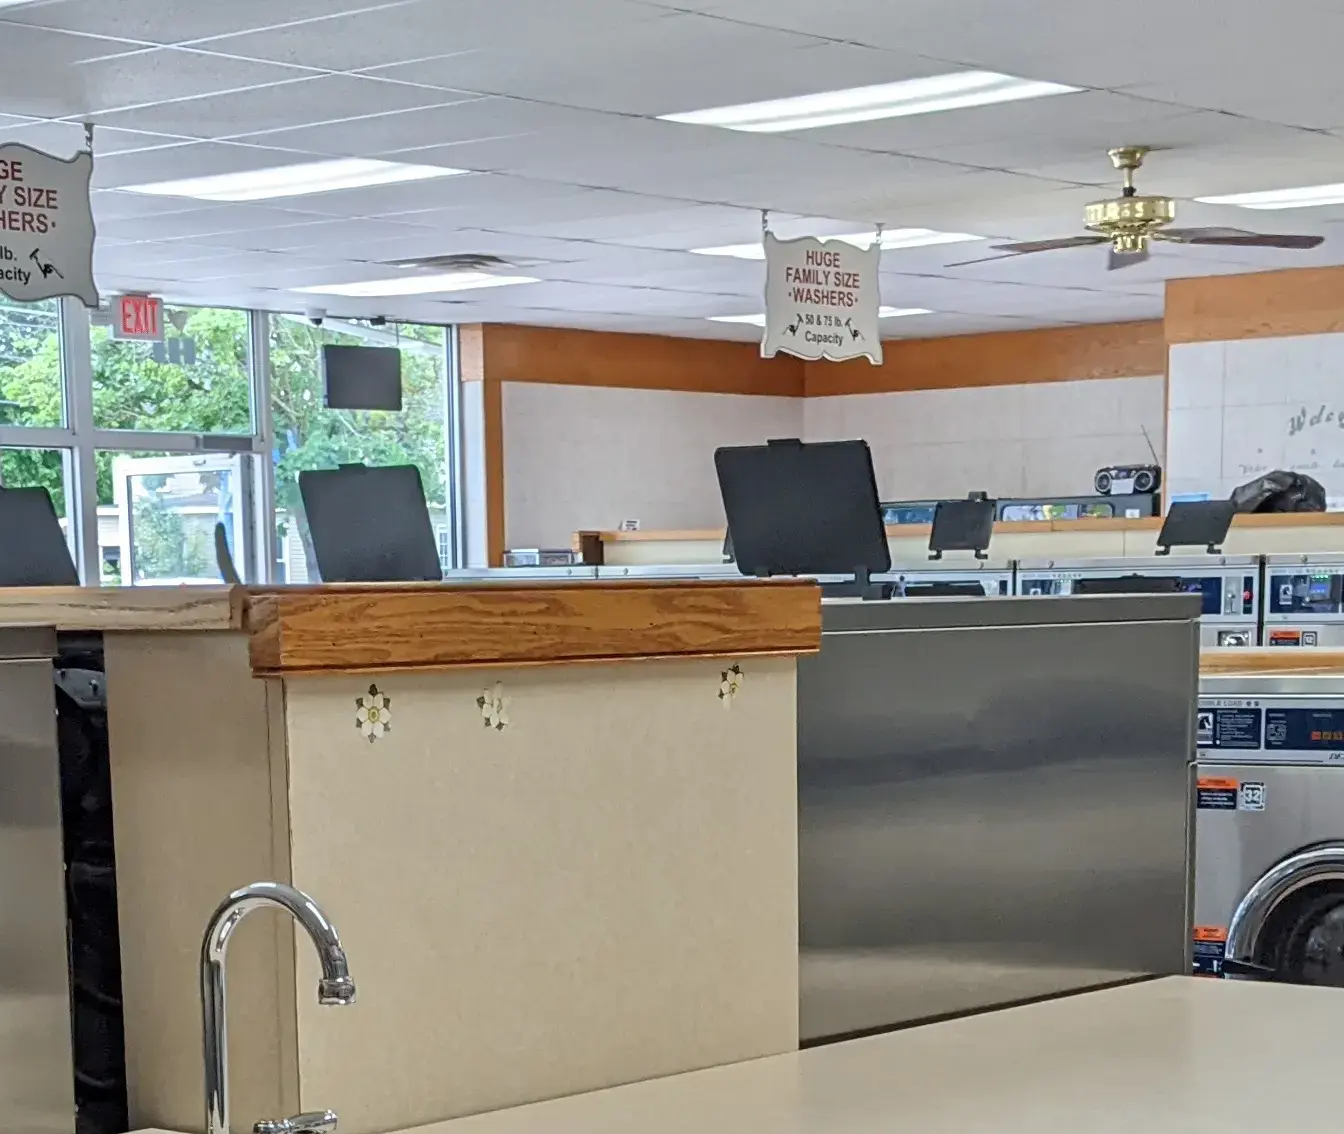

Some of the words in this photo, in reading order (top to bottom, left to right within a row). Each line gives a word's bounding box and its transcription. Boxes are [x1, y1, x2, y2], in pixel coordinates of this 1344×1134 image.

[14, 186, 58, 210] SIZE
[0, 245, 18, 261] lb.
[806, 250, 840, 267] HUGE
[786, 267, 830, 285] FAMILY
[834, 271, 859, 288] SIZE
[122, 297, 159, 335] EXIT
[805, 330, 844, 347] Capacity
